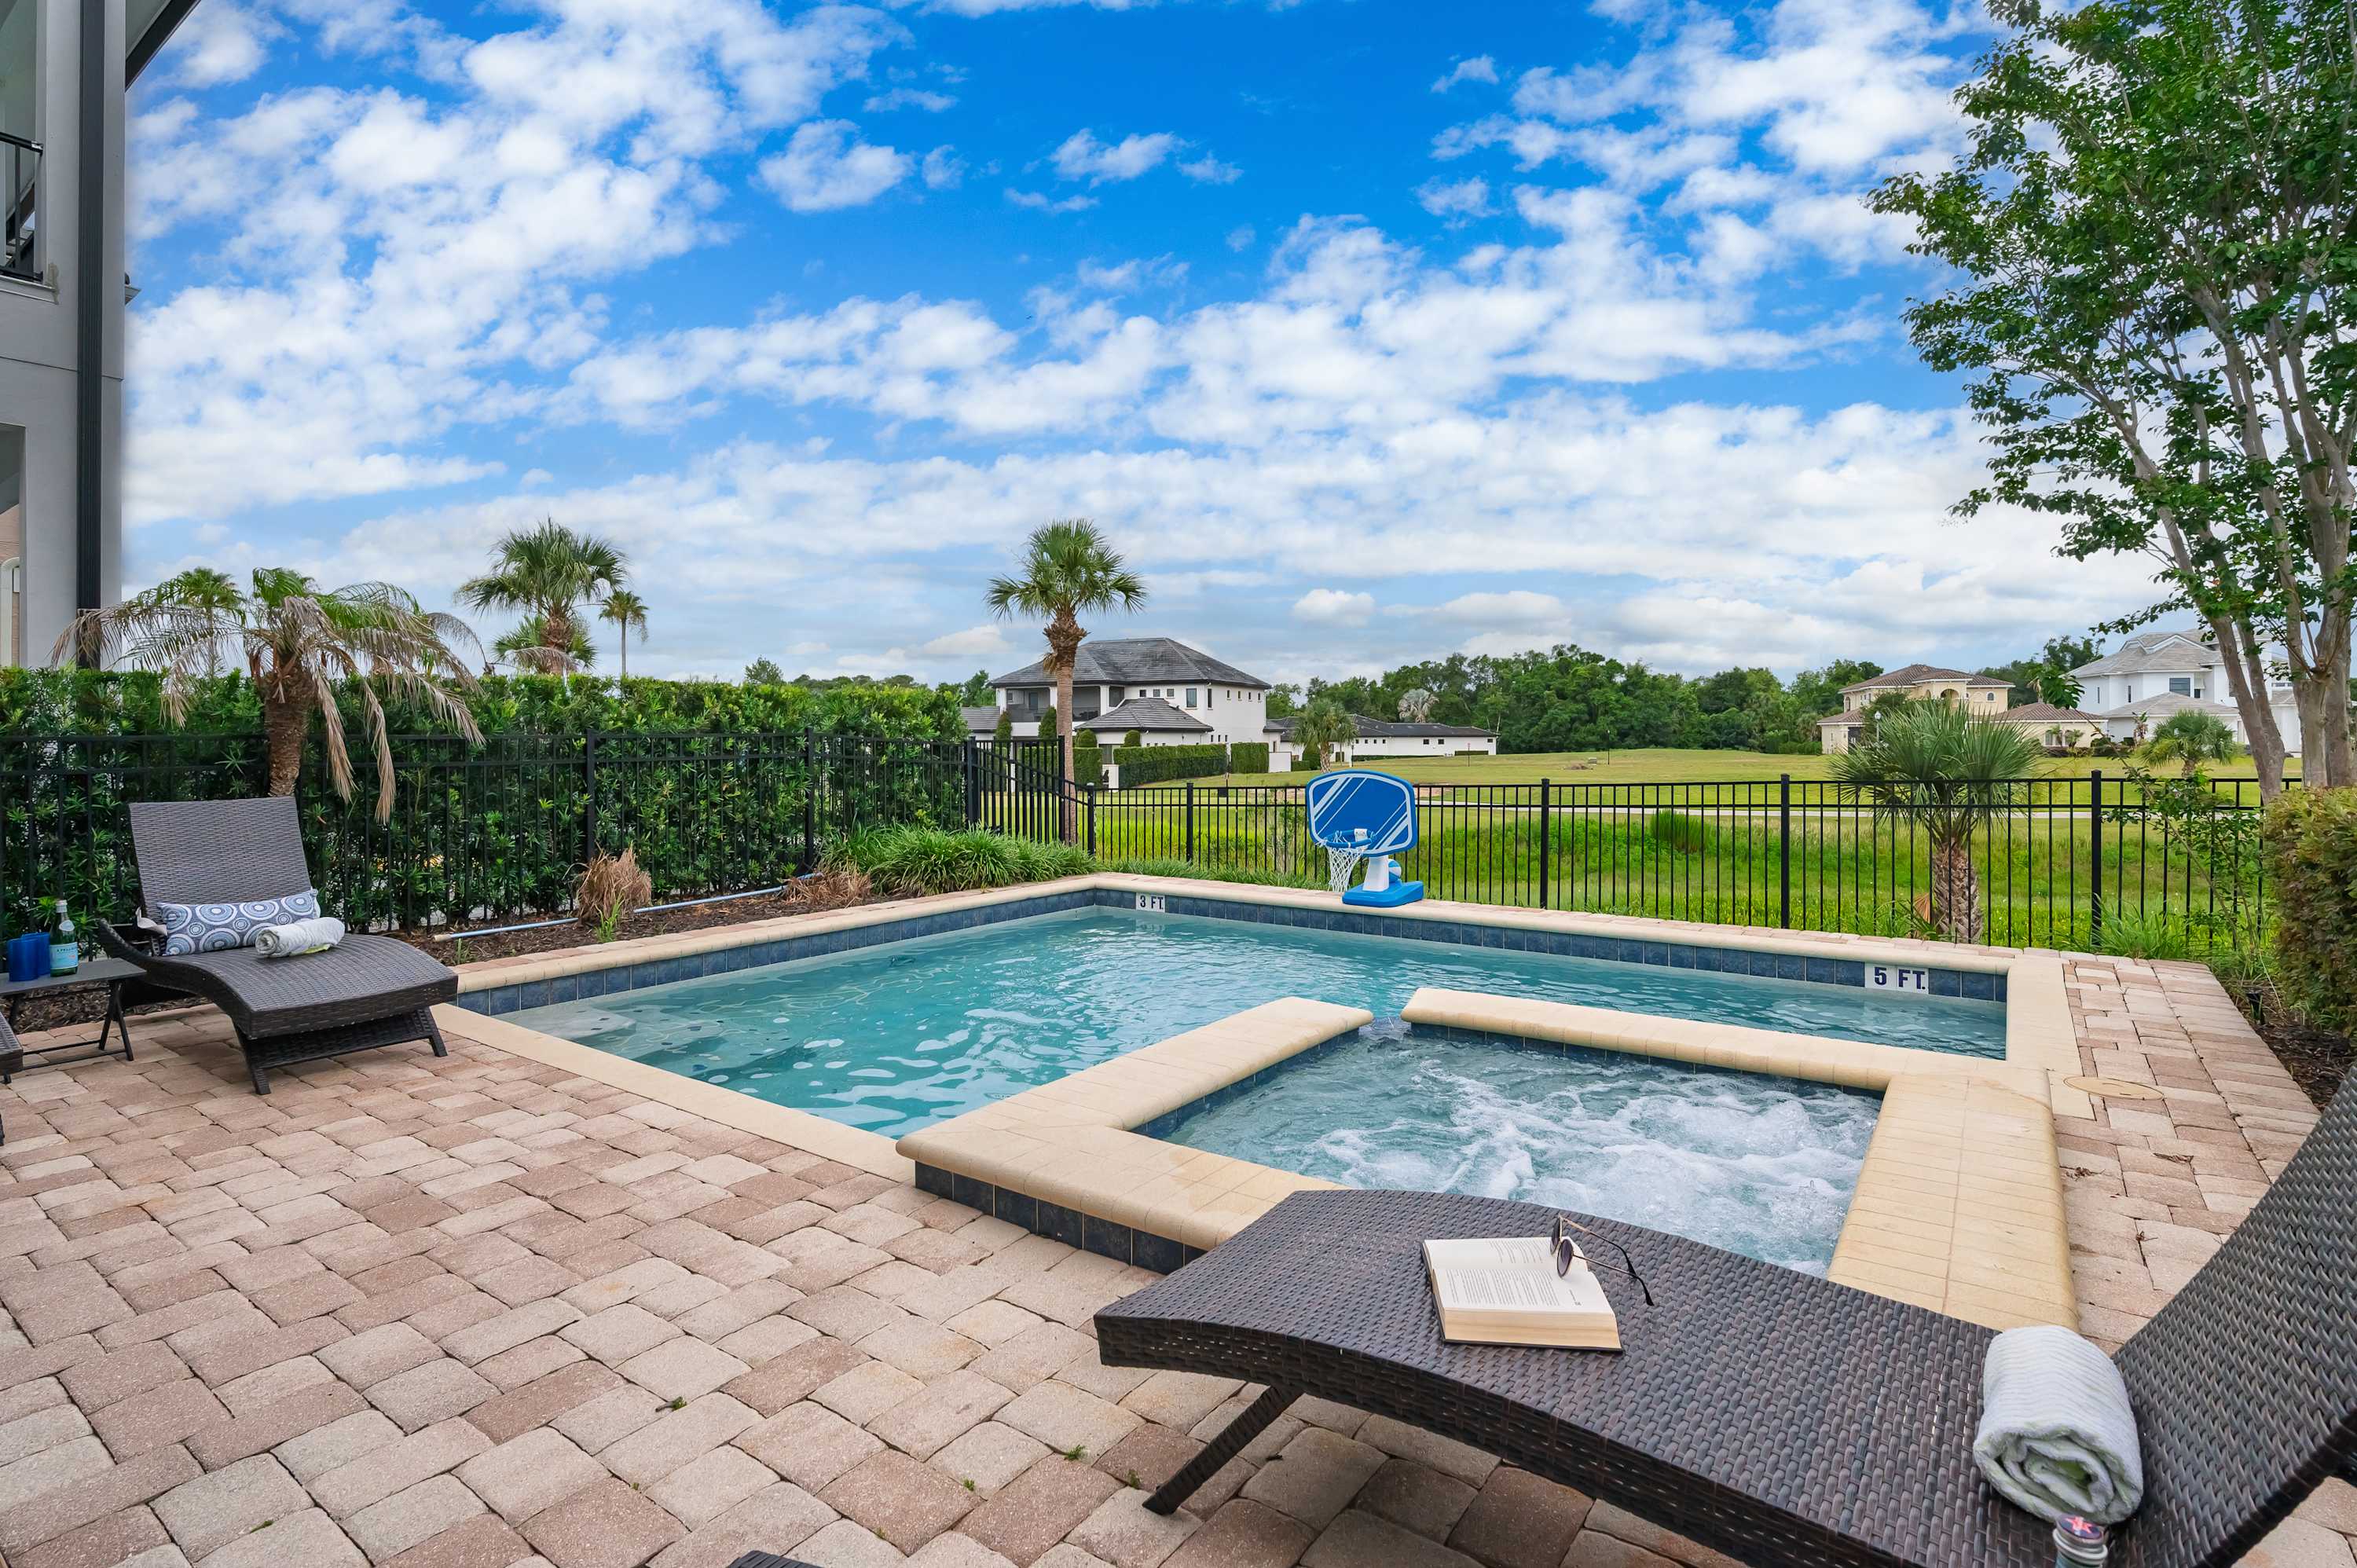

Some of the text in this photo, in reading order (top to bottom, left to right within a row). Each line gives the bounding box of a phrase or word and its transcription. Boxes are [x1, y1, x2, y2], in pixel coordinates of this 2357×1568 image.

[1140, 895, 1146, 908] 3
[1874, 966, 1926, 991] 5 FT.
